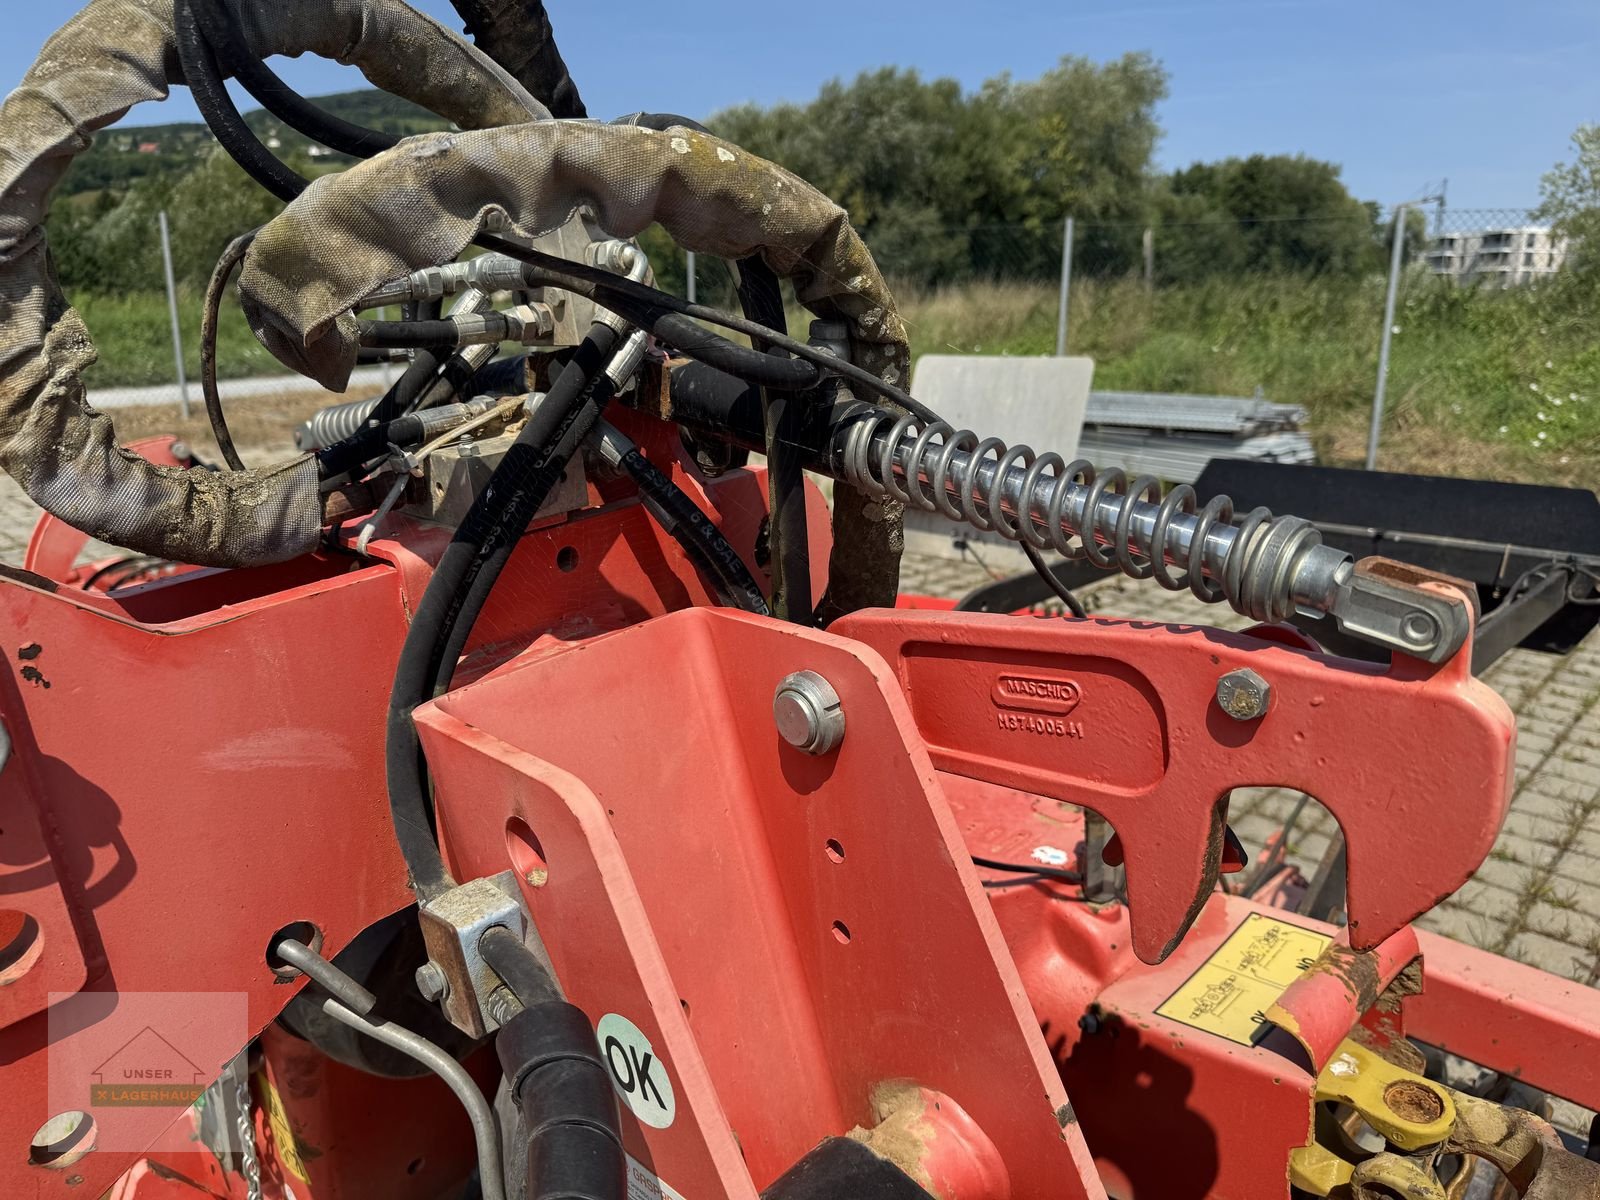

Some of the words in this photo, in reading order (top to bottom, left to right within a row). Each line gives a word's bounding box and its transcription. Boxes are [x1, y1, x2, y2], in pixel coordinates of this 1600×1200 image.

[713, 537, 741, 574] SAE
[1006, 679, 1072, 701] MASCHIO
[605, 1035, 667, 1111] OK
